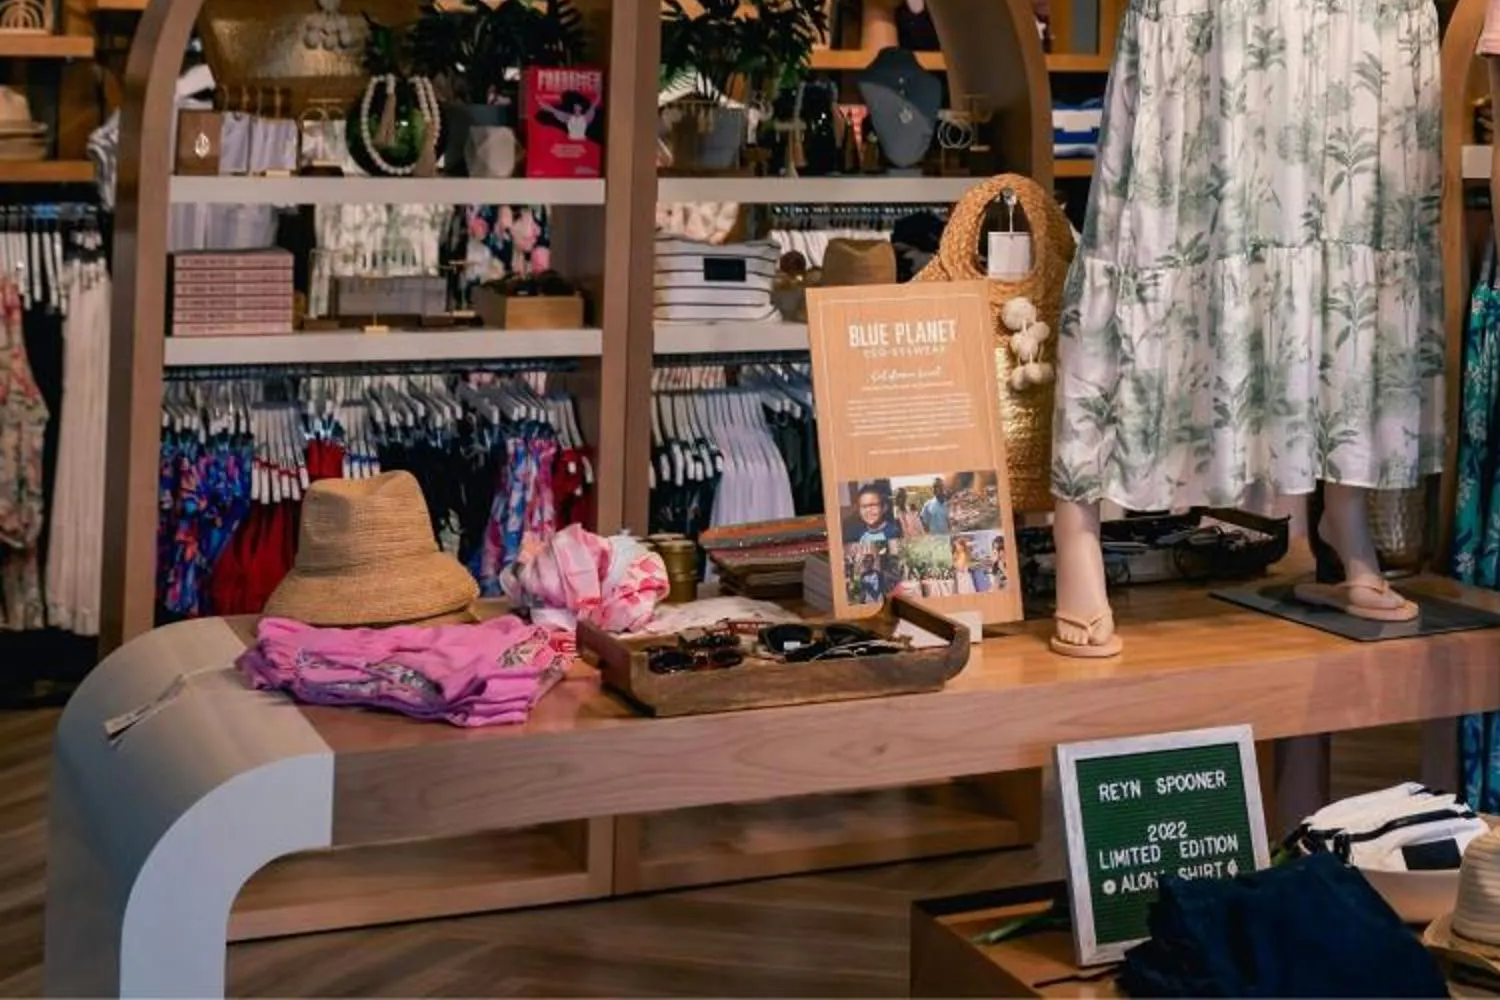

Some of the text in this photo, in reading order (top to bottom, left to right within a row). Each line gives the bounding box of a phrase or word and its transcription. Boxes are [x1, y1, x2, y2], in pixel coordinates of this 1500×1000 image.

[848, 318, 957, 348] BLUE PLANET
[1098, 769, 1228, 802] REYN SPOONER
[1147, 820, 1188, 842] 2022
[1099, 832, 1239, 870] LIMITED EDITION
[1121, 860, 1224, 894] ALOH SHIRT
